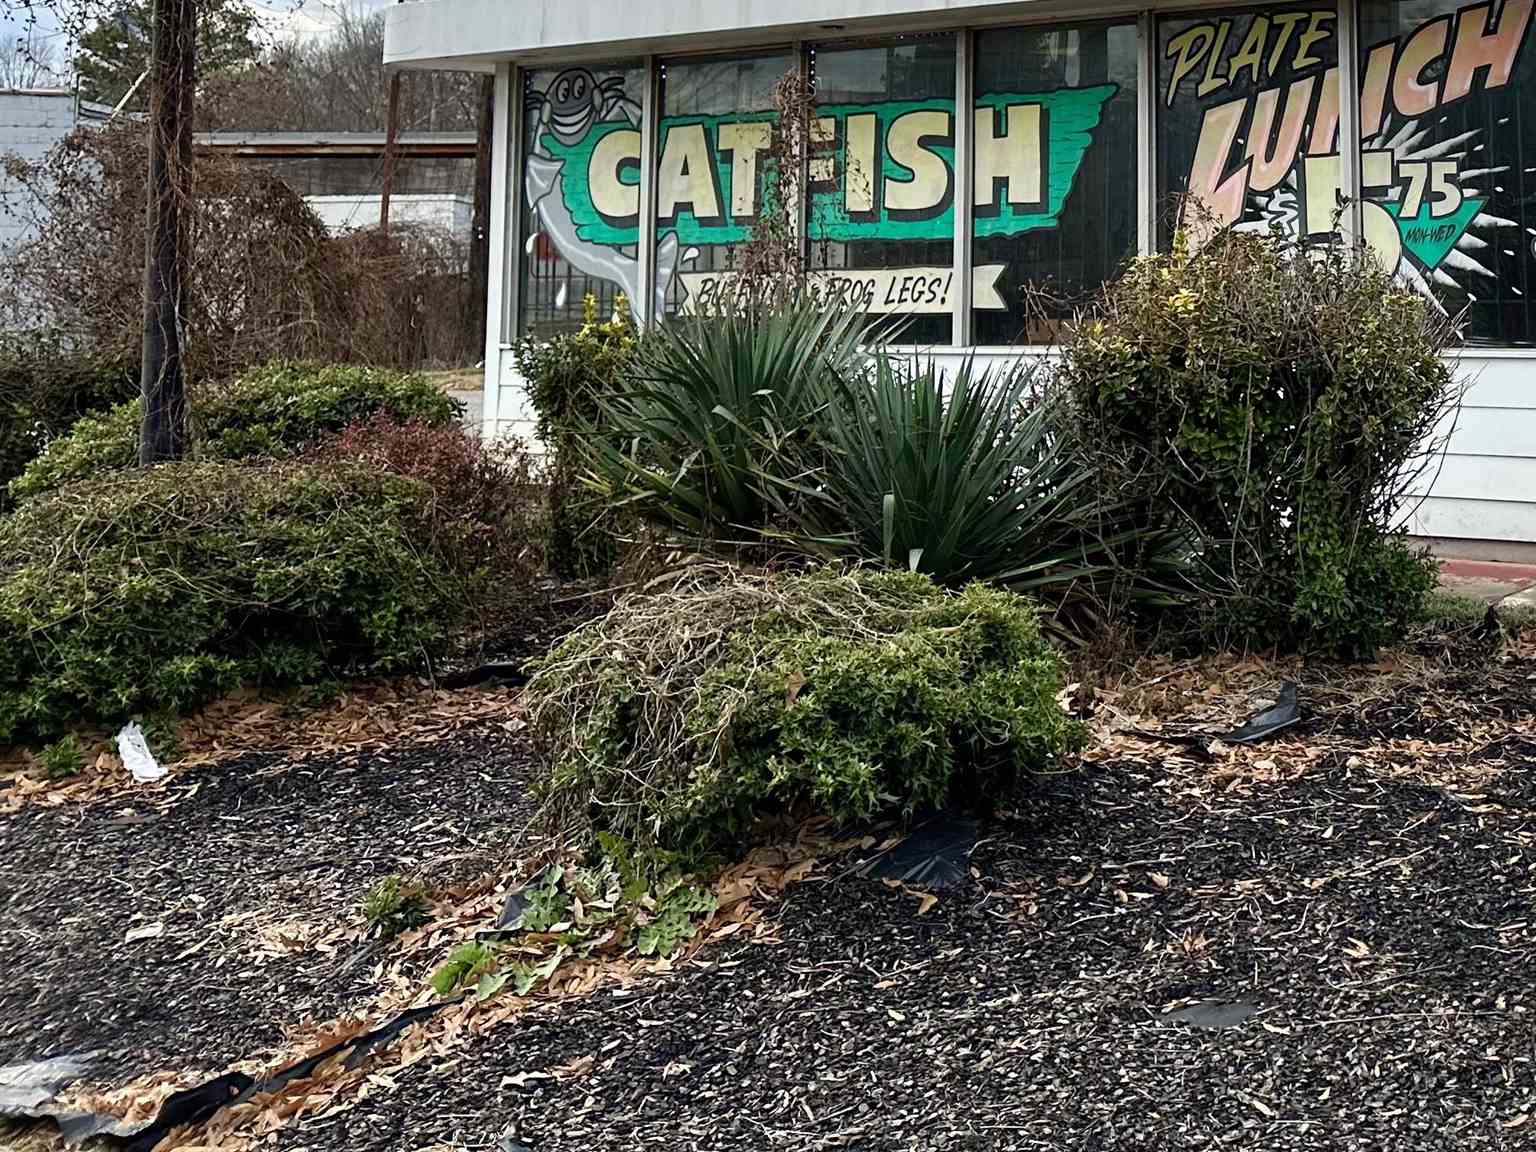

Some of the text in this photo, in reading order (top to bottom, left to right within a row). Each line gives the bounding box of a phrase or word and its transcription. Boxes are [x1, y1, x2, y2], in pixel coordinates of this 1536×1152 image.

[1165, 11, 1337, 107] PLATE
[1404, 224, 1457, 244] MON-WED
[883, 272, 953, 305] LEGS!
